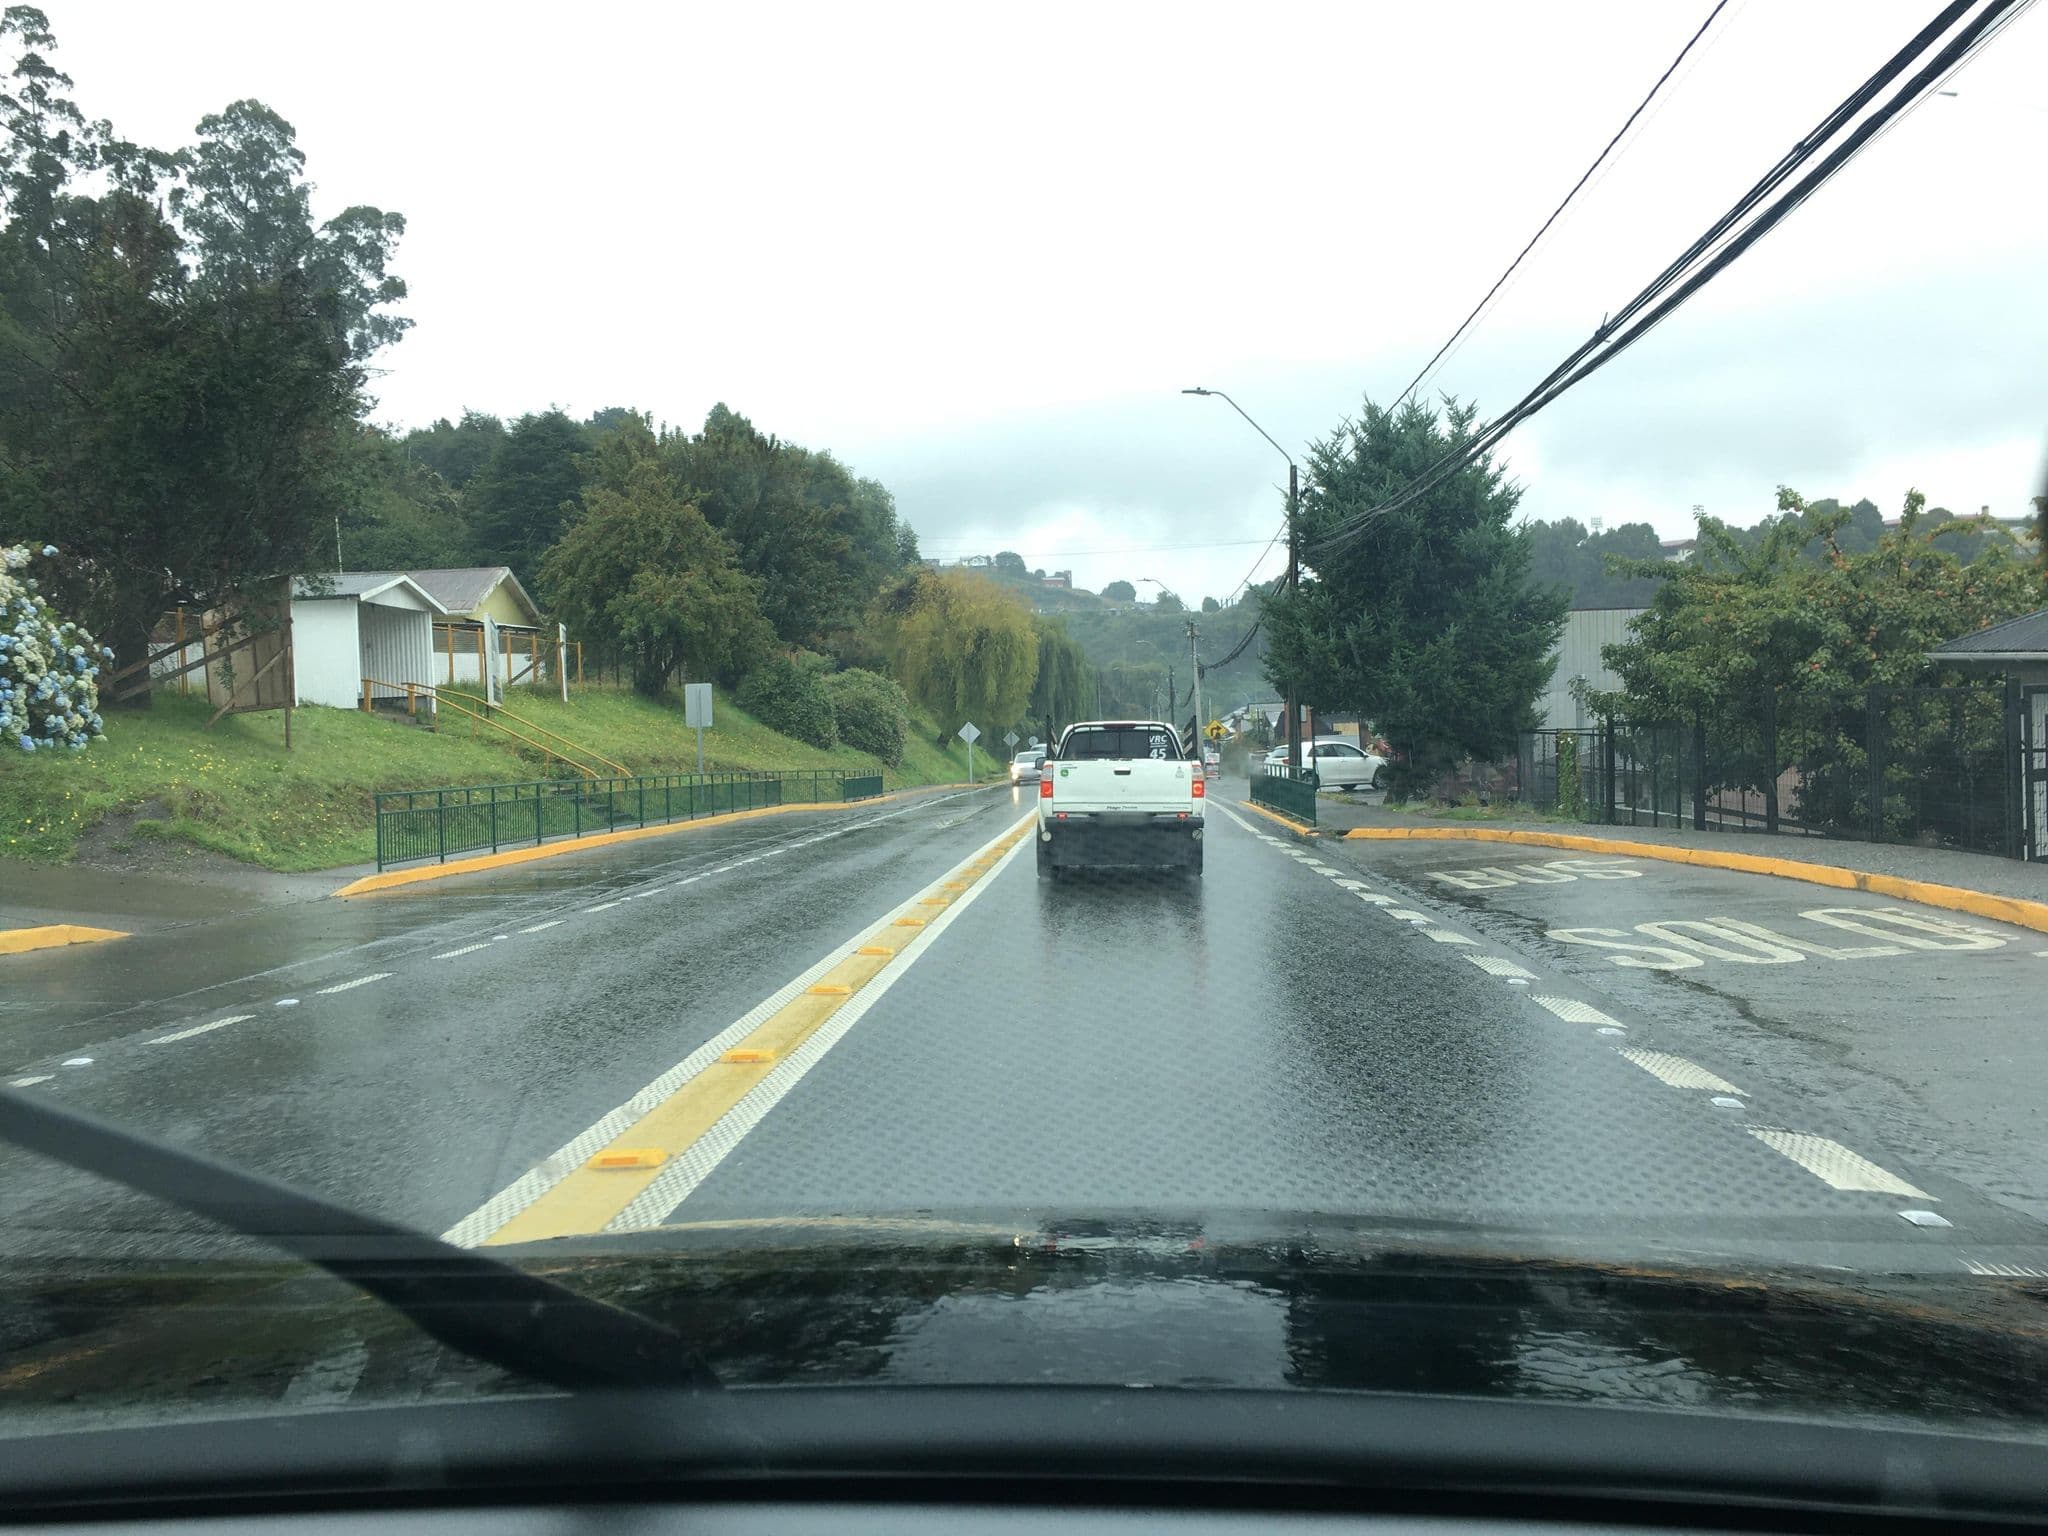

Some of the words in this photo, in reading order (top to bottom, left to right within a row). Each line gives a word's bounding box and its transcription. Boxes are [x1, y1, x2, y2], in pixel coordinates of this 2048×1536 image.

[1149, 748, 1167, 760] 45
[1424, 860, 1643, 890] BUS
[1545, 906, 2019, 970] SOLO
